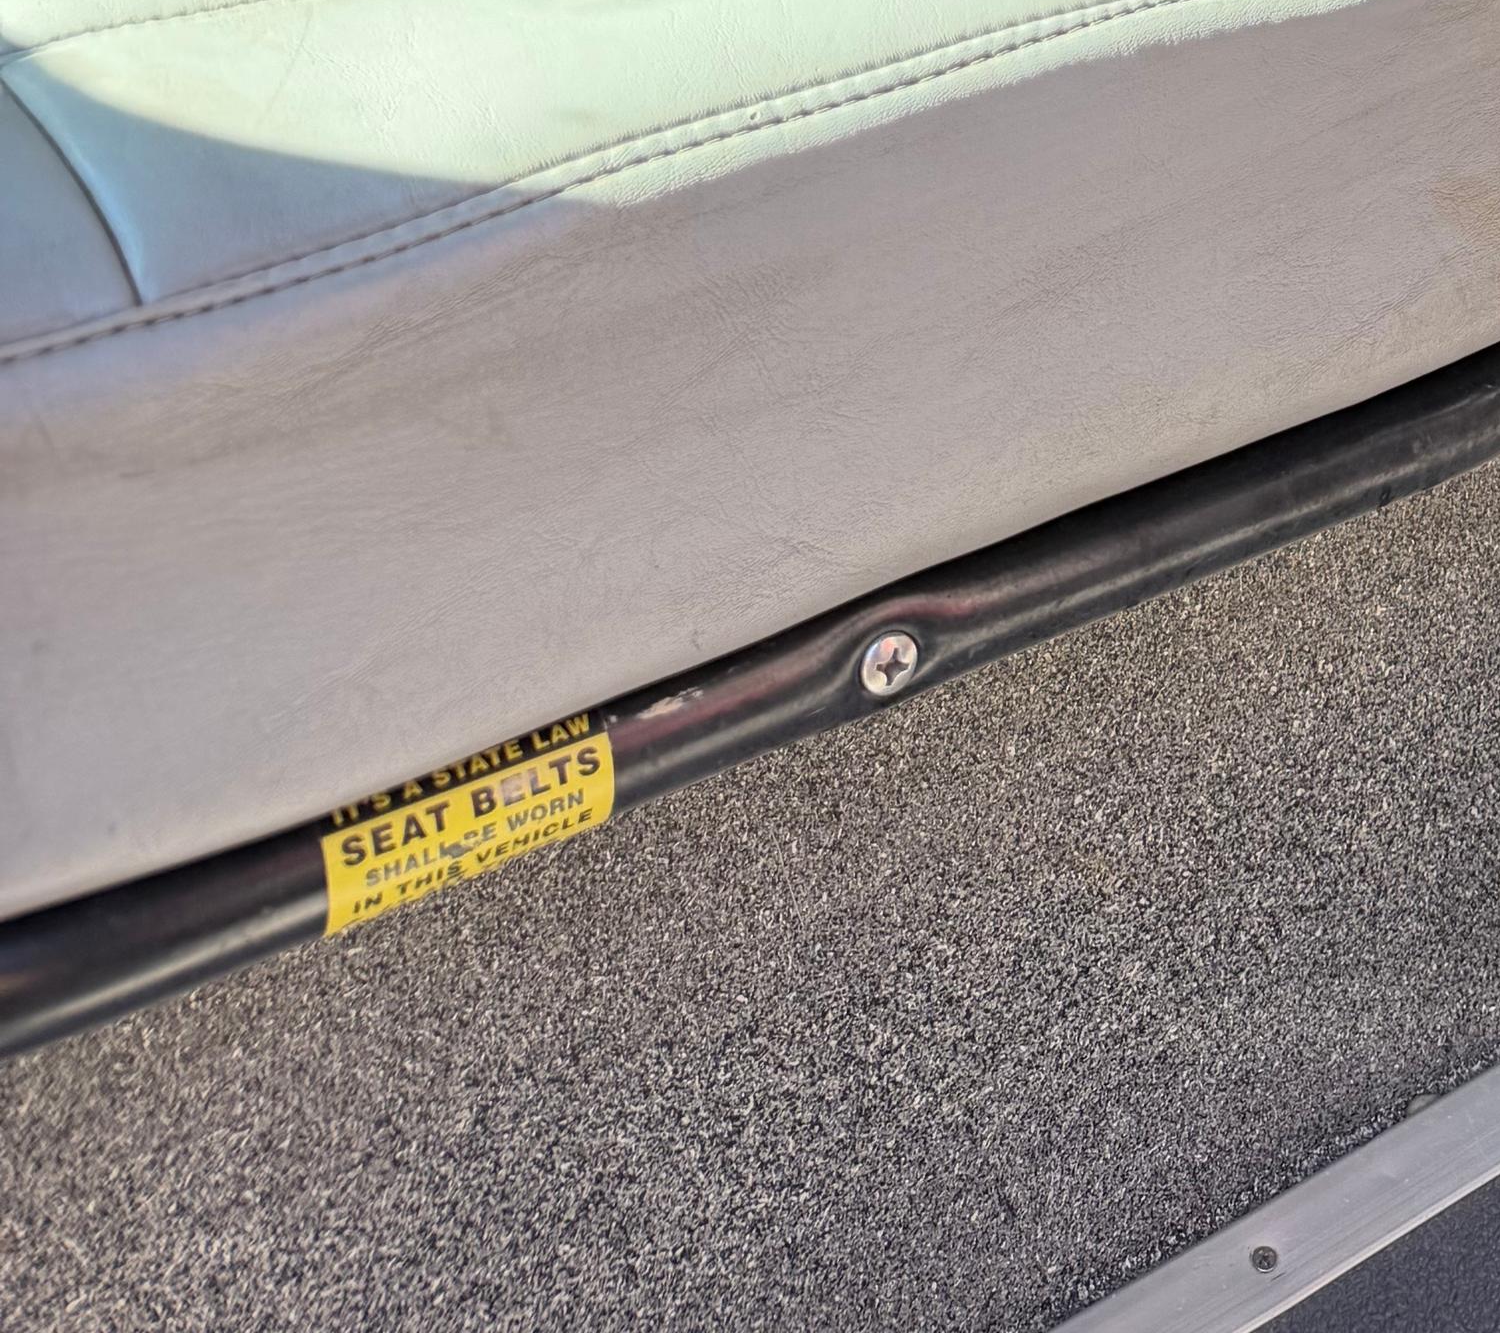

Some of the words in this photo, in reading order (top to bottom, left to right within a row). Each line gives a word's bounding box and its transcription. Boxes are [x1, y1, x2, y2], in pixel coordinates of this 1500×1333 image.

[341, 801, 451, 867] SEAT
[470, 746, 601, 818] BELTS
[403, 780, 423, 806] A
[432, 739, 523, 788] STATE
[531, 713, 591, 751] LAW
[506, 788, 585, 831] WORN
[352, 893, 383, 915] IN
[396, 860, 462, 896] THIS
[476, 807, 593, 865] VEHICLE
